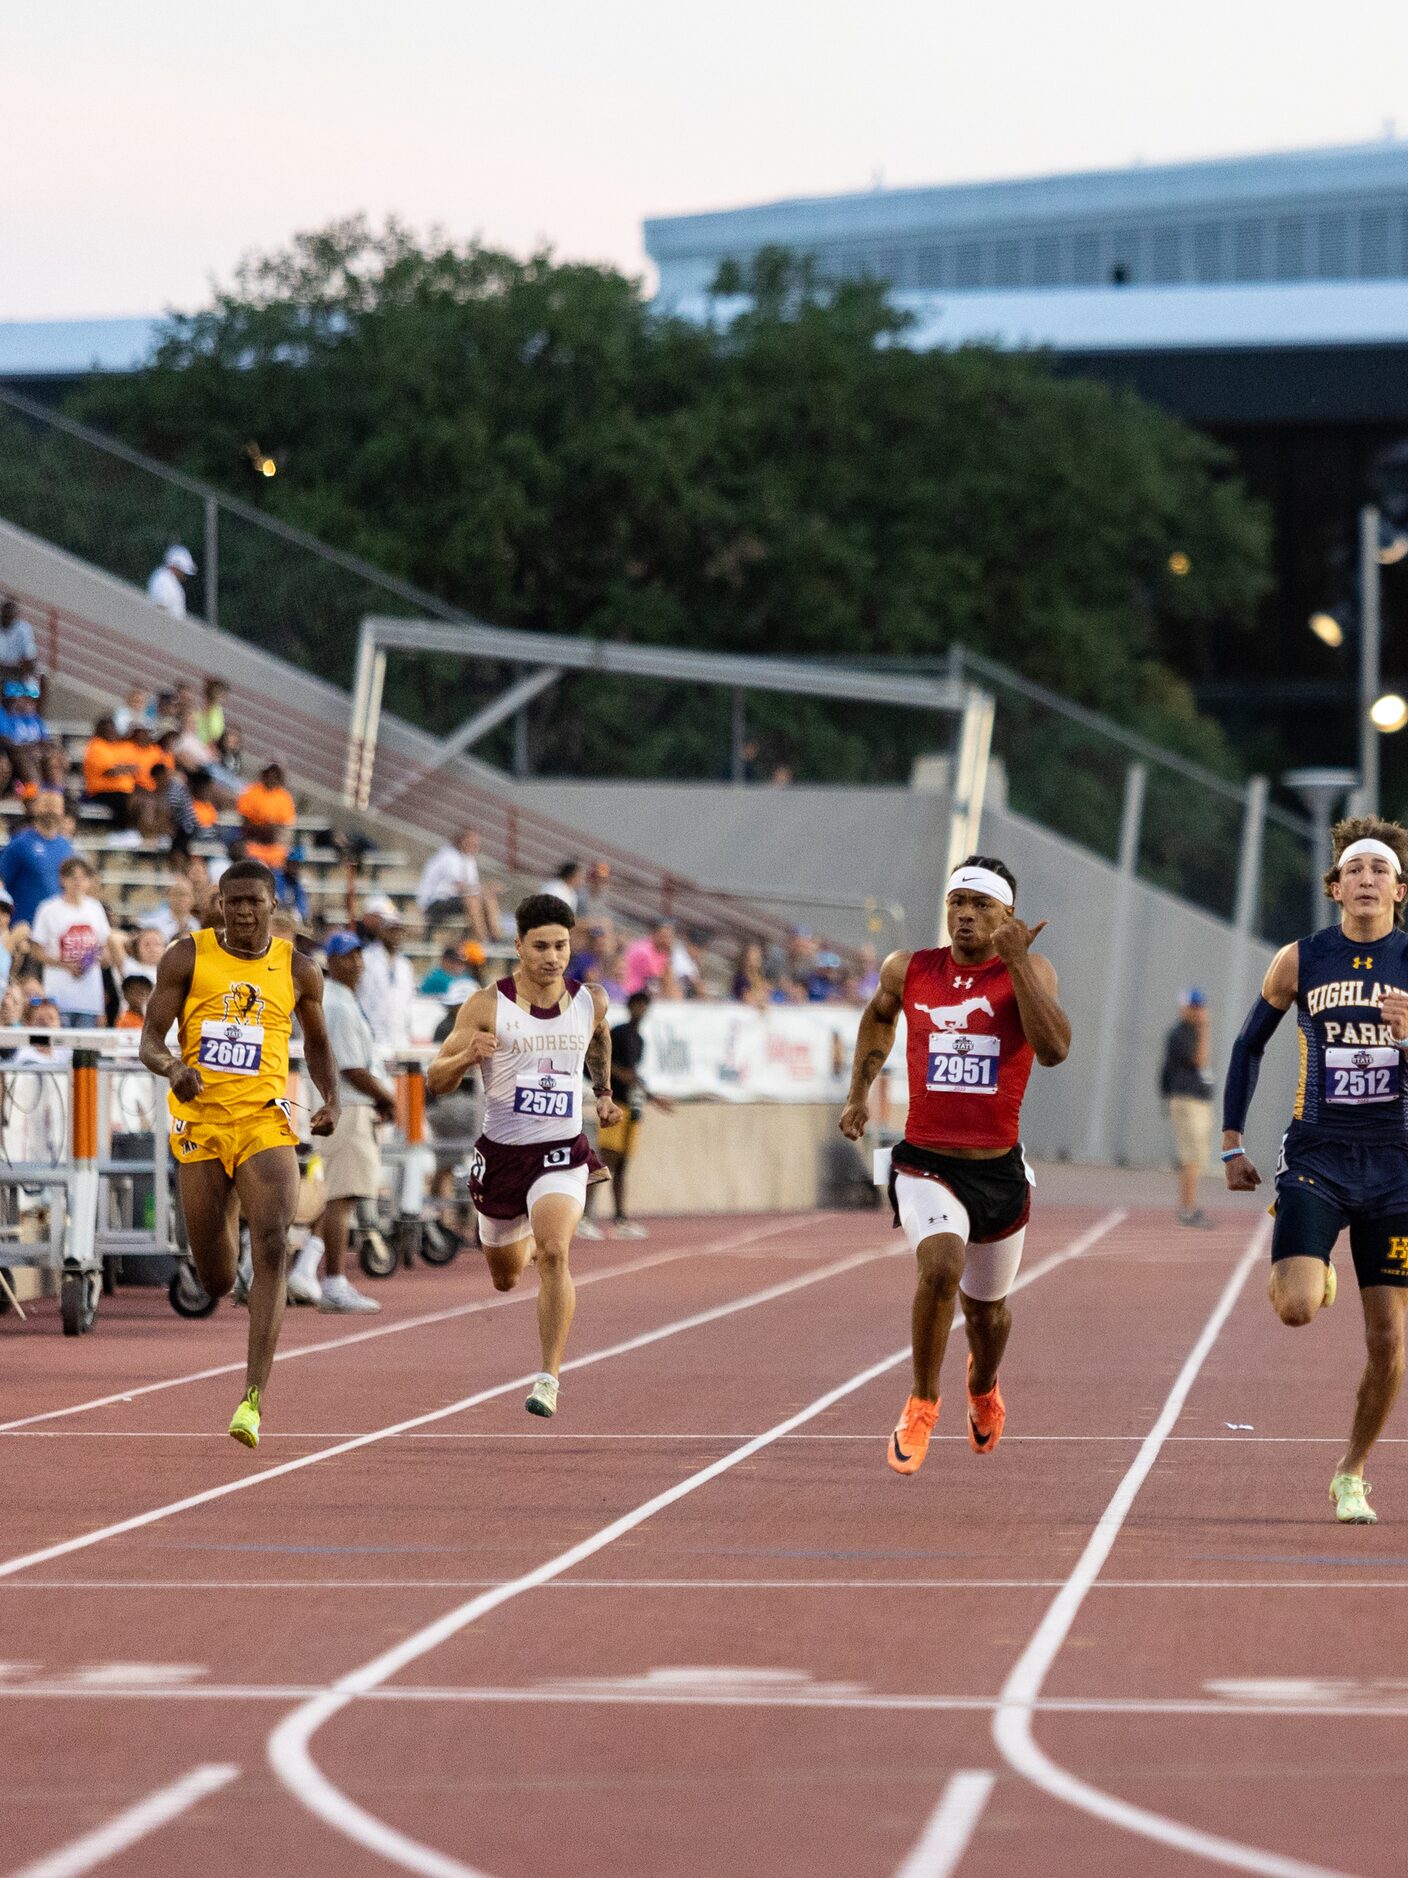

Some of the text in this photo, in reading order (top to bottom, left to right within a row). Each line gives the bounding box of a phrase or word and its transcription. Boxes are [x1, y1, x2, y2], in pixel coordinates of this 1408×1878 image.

[204, 1039, 257, 1068] 2607
[511, 1034, 584, 1056] ANDRESS
[933, 1055, 991, 1085] 2951
[1334, 1069, 1391, 1097] 2512
[519, 1090, 568, 1116] 2579
